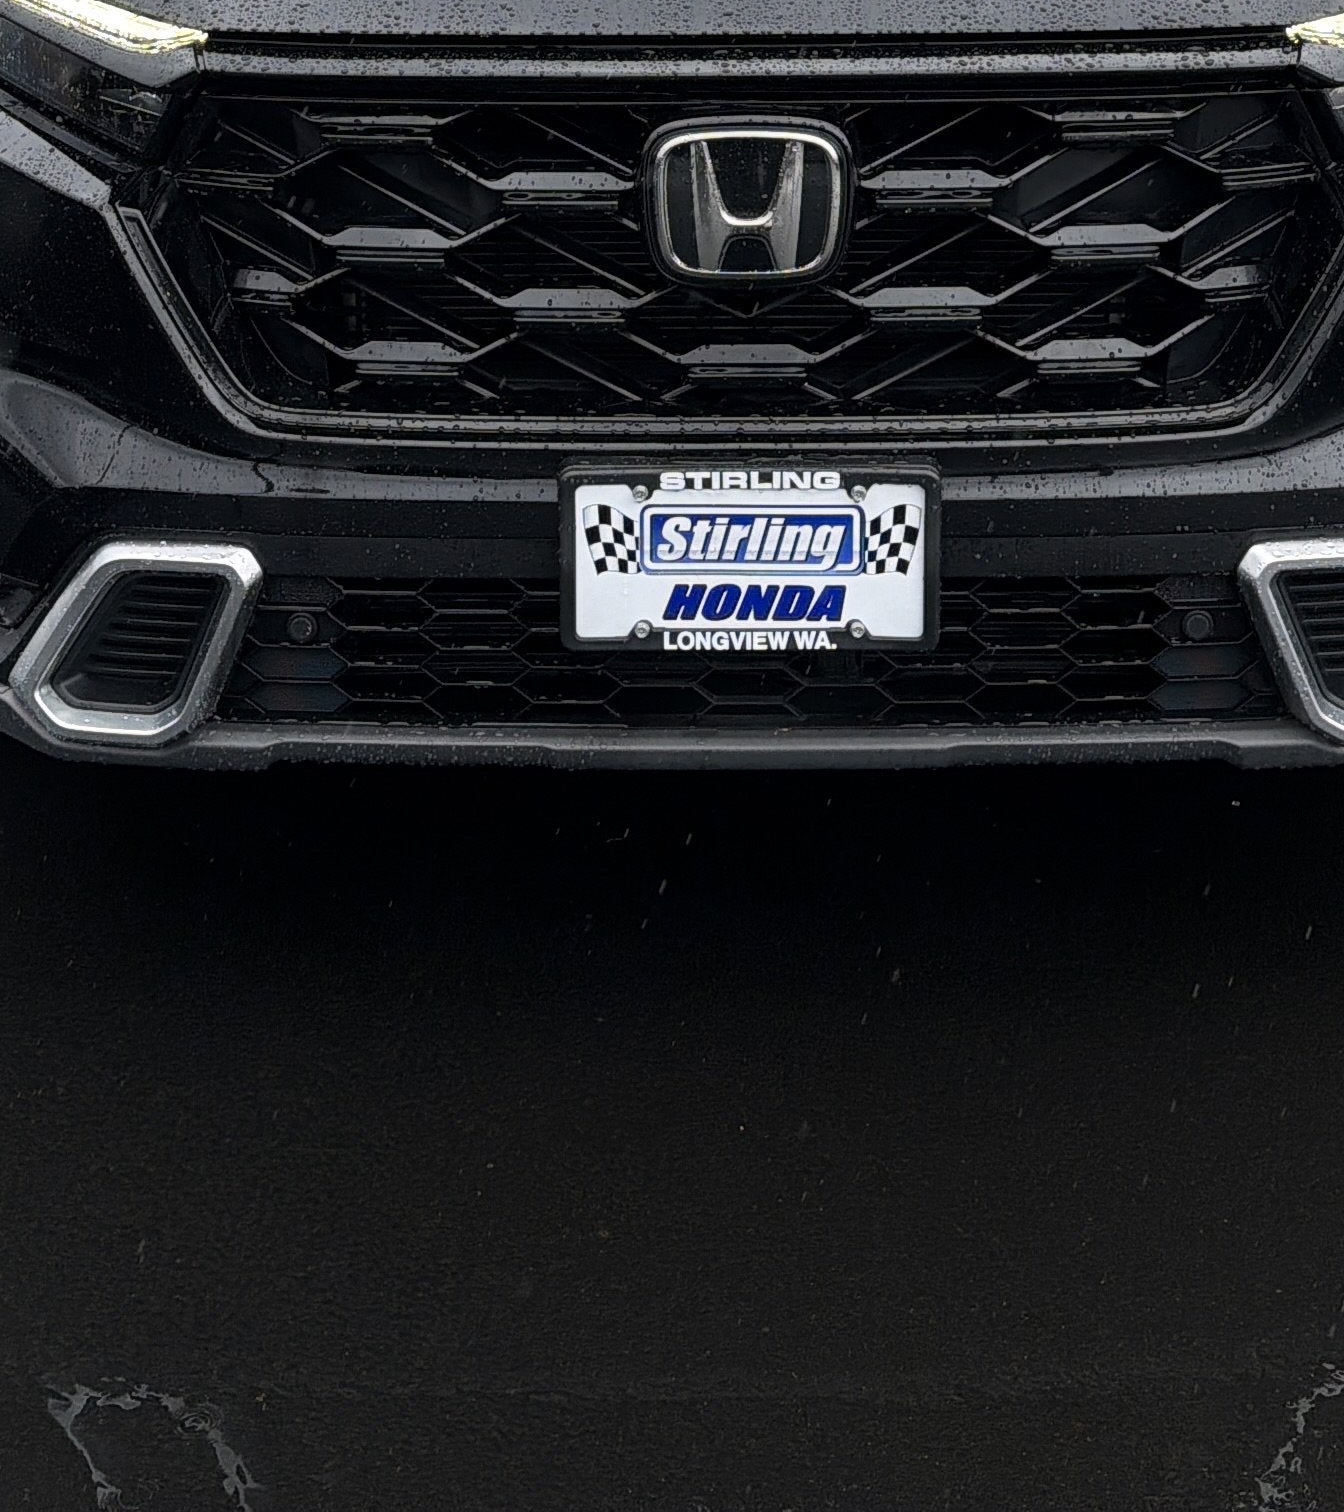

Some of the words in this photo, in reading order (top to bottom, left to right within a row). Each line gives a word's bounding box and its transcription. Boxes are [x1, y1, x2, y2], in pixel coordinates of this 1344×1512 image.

[659, 470, 841, 490] STIRLING
[657, 516, 847, 571] Stirling
[662, 584, 847, 621] HONDA
[663, 631, 791, 651] LONGVIEW
[792, 631, 838, 650] WA.
